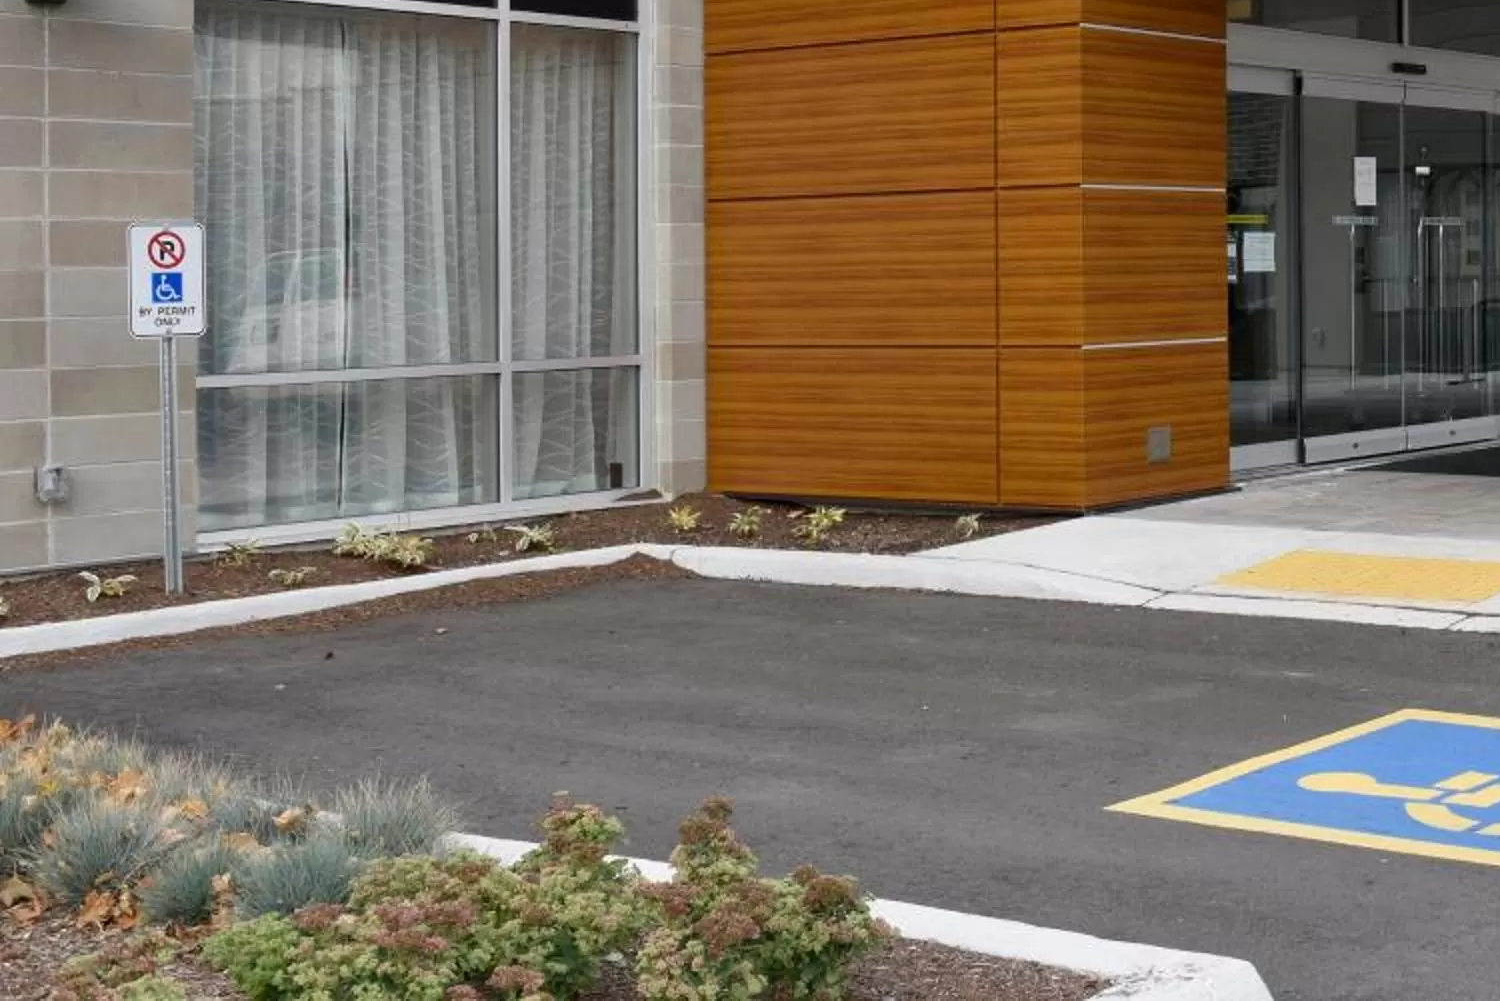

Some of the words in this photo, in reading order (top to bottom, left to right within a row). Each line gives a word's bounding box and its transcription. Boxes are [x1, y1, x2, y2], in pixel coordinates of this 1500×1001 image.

[139, 306, 153, 317] BY
[157, 306, 196, 316] PERMIT
[154, 317, 181, 327] ONLY
